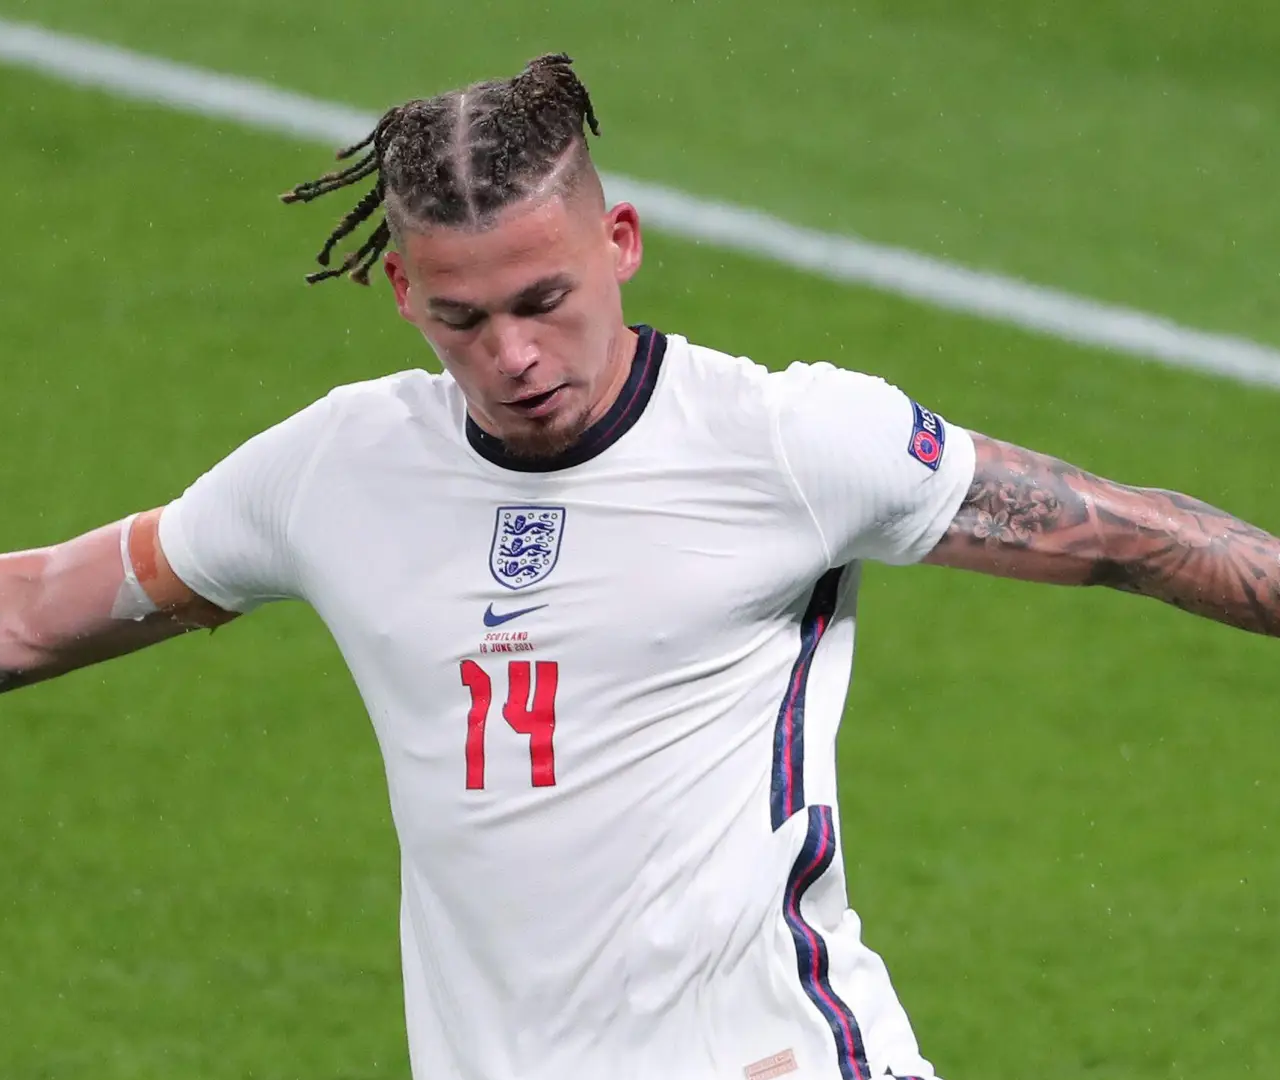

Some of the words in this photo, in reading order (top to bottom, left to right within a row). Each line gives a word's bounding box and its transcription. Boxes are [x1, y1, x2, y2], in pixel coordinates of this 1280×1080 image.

[484, 631, 528, 641] SCOTLAND
[490, 642, 513, 653] JUNE
[514, 642, 534, 652] 2021
[459, 659, 559, 790] 14
